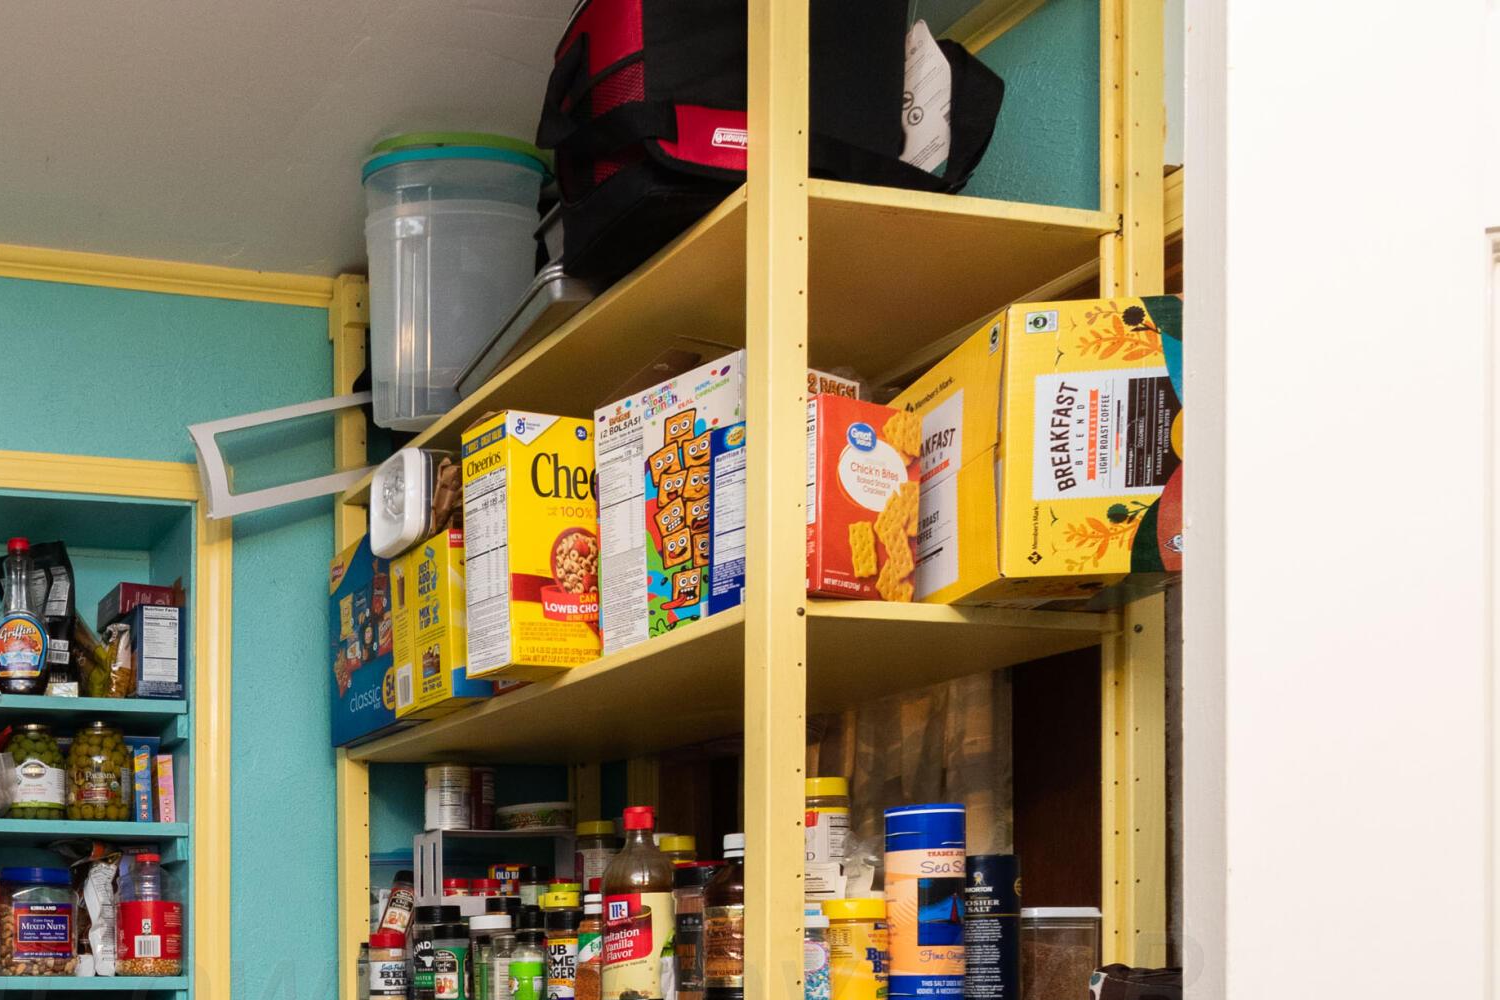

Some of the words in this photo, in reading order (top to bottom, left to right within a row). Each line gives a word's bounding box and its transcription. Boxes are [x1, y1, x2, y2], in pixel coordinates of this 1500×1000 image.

[641, 381, 678, 404] Cinnamon
[807, 373, 818, 395] 2
[819, 379, 857, 399] BAGS!
[647, 391, 672, 408] Toast
[915, 385, 940, 411] Member's
[643, 395, 679, 420] Crunch
[1101, 393, 1111, 422] COFFEE
[600, 428, 608, 439] 12
[609, 415, 642, 437] BOLSAS!
[850, 428, 872, 439] Great
[1050, 381, 1079, 492] BREAKFAST
[1075, 403, 1085, 466] BLEND
[1100, 424, 1110, 450] ROAST
[855, 438, 872, 447] Value
[920, 427, 956, 457] AKFAST
[467, 451, 501, 478] Cheerios
[1099, 451, 1109, 475] LIGHT
[851, 462, 880, 476] Chick'n
[882, 469, 899, 481] Bites
[873, 479, 891, 489] Snack
[560, 506, 593, 519] 100%
[1031, 517, 1040, 550] Member's
[418, 561, 430, 574] JUST
[418, 573, 430, 586] ADD
[418, 585, 431, 598] MILK
[579, 595, 597, 603] CAN
[419, 608, 430, 620] MIX
[544, 602, 578, 614] LOWER
[350, 684, 381, 713] classic
[921, 861, 950, 874] Sea
[496, 871, 509, 879] OLD
[21, 922, 46, 930] MIXED
[47, 922, 66, 930] NUTS
[604, 928, 640, 943] mitation
[550, 944, 567, 955] UB
[605, 939, 634, 952] Vanilla
[607, 949, 634, 961] Flavor
[920, 950, 946, 962] Fine
